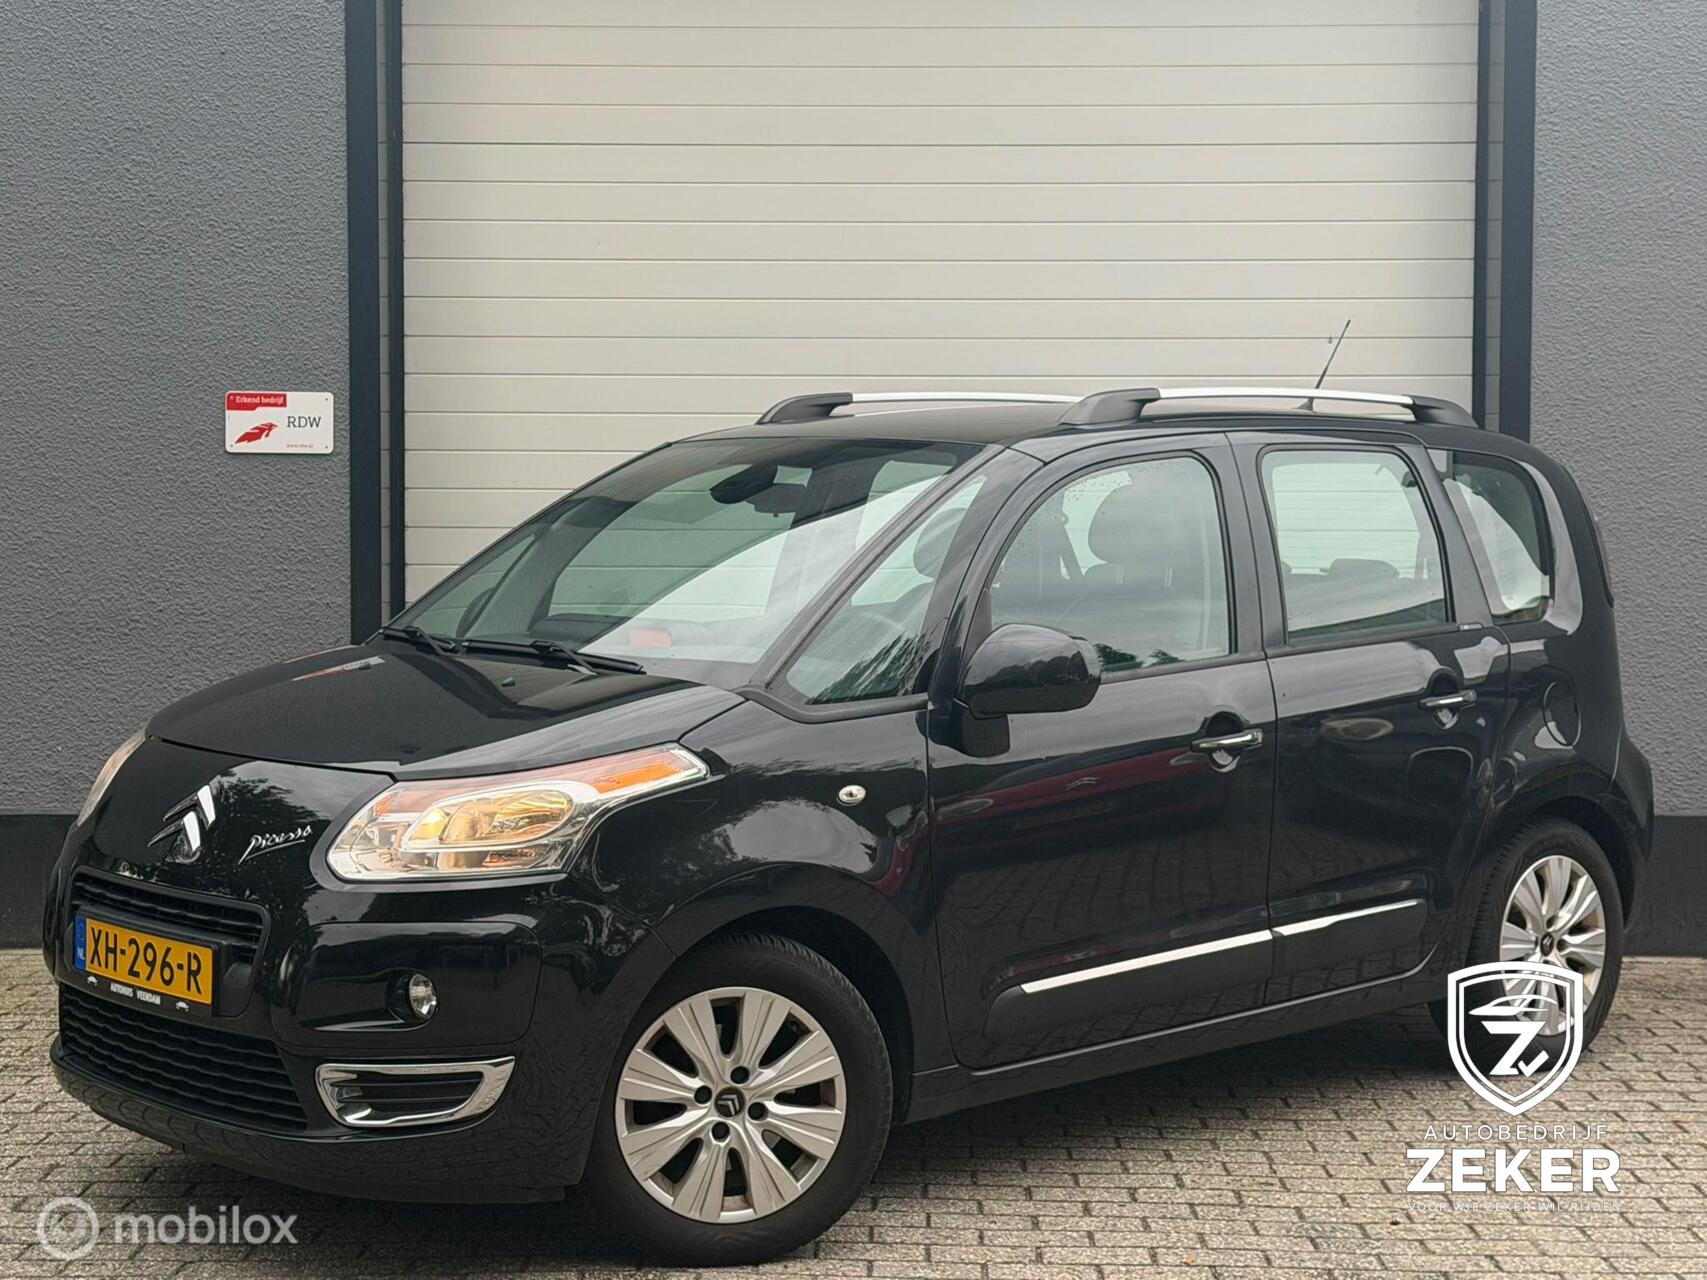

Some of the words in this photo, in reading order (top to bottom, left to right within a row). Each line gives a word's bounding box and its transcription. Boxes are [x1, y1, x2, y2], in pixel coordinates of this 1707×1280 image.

[235, 396, 260, 404] Erkend
[261, 396, 284, 406] bedrijf
[286, 415, 322, 428] RDW
[237, 825, 313, 865] Picasso
[77, 947, 86, 961] NL
[90, 926, 203, 995] XH-296-R
